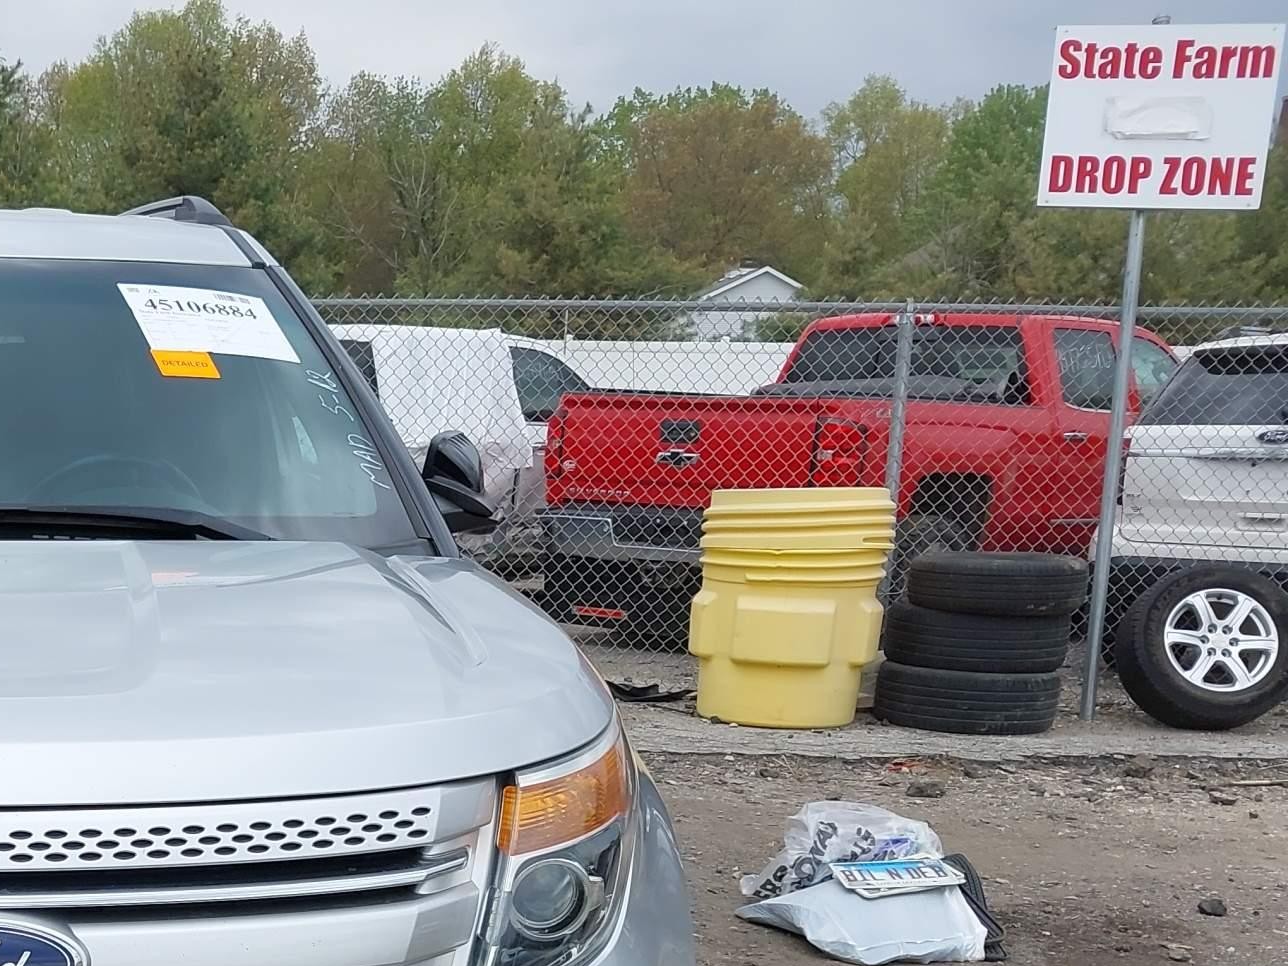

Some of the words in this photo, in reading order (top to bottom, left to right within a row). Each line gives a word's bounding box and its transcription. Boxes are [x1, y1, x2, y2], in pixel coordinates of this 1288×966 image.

[1058, 39, 1163, 80] State
[1172, 39, 1276, 80] Farm
[1048, 155, 1153, 194] DROP
[1159, 156, 1257, 196] ZONE
[144, 298, 258, 320] 45106884
[161, 359, 209, 369] DETAILED
